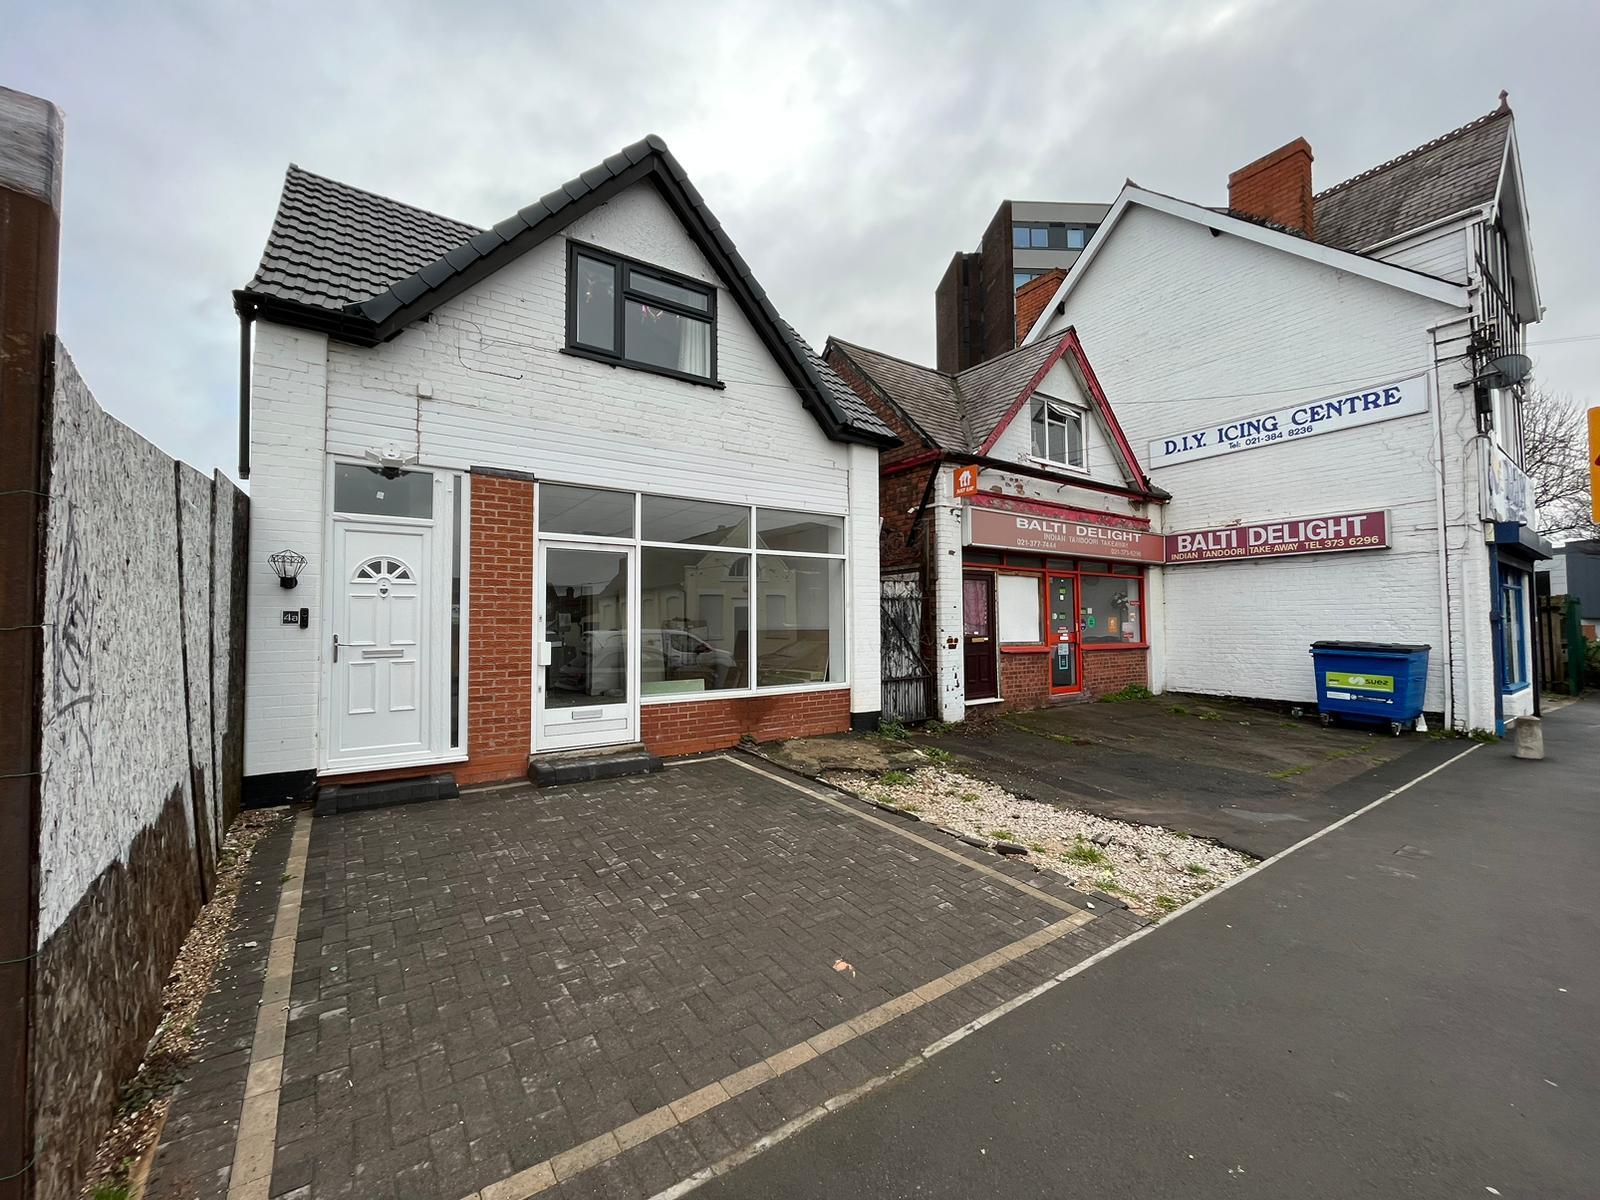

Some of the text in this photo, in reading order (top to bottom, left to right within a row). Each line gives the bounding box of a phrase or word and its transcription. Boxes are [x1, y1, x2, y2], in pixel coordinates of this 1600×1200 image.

[1165, 386, 1402, 455] D.I.Y. ICING CENTRE
[1245, 431, 1283, 446] 021-384
[1288, 425, 1313, 438] 8236
[1016, 518, 1142, 543] BALTI DELIGHT
[1043, 533, 1066, 543] INDIAN
[1178, 515, 1367, 552] BALTI DELIGHT
[1171, 535, 1379, 560] INDIAN TANDOORI TAKE-AWAY TEL 373 6296
